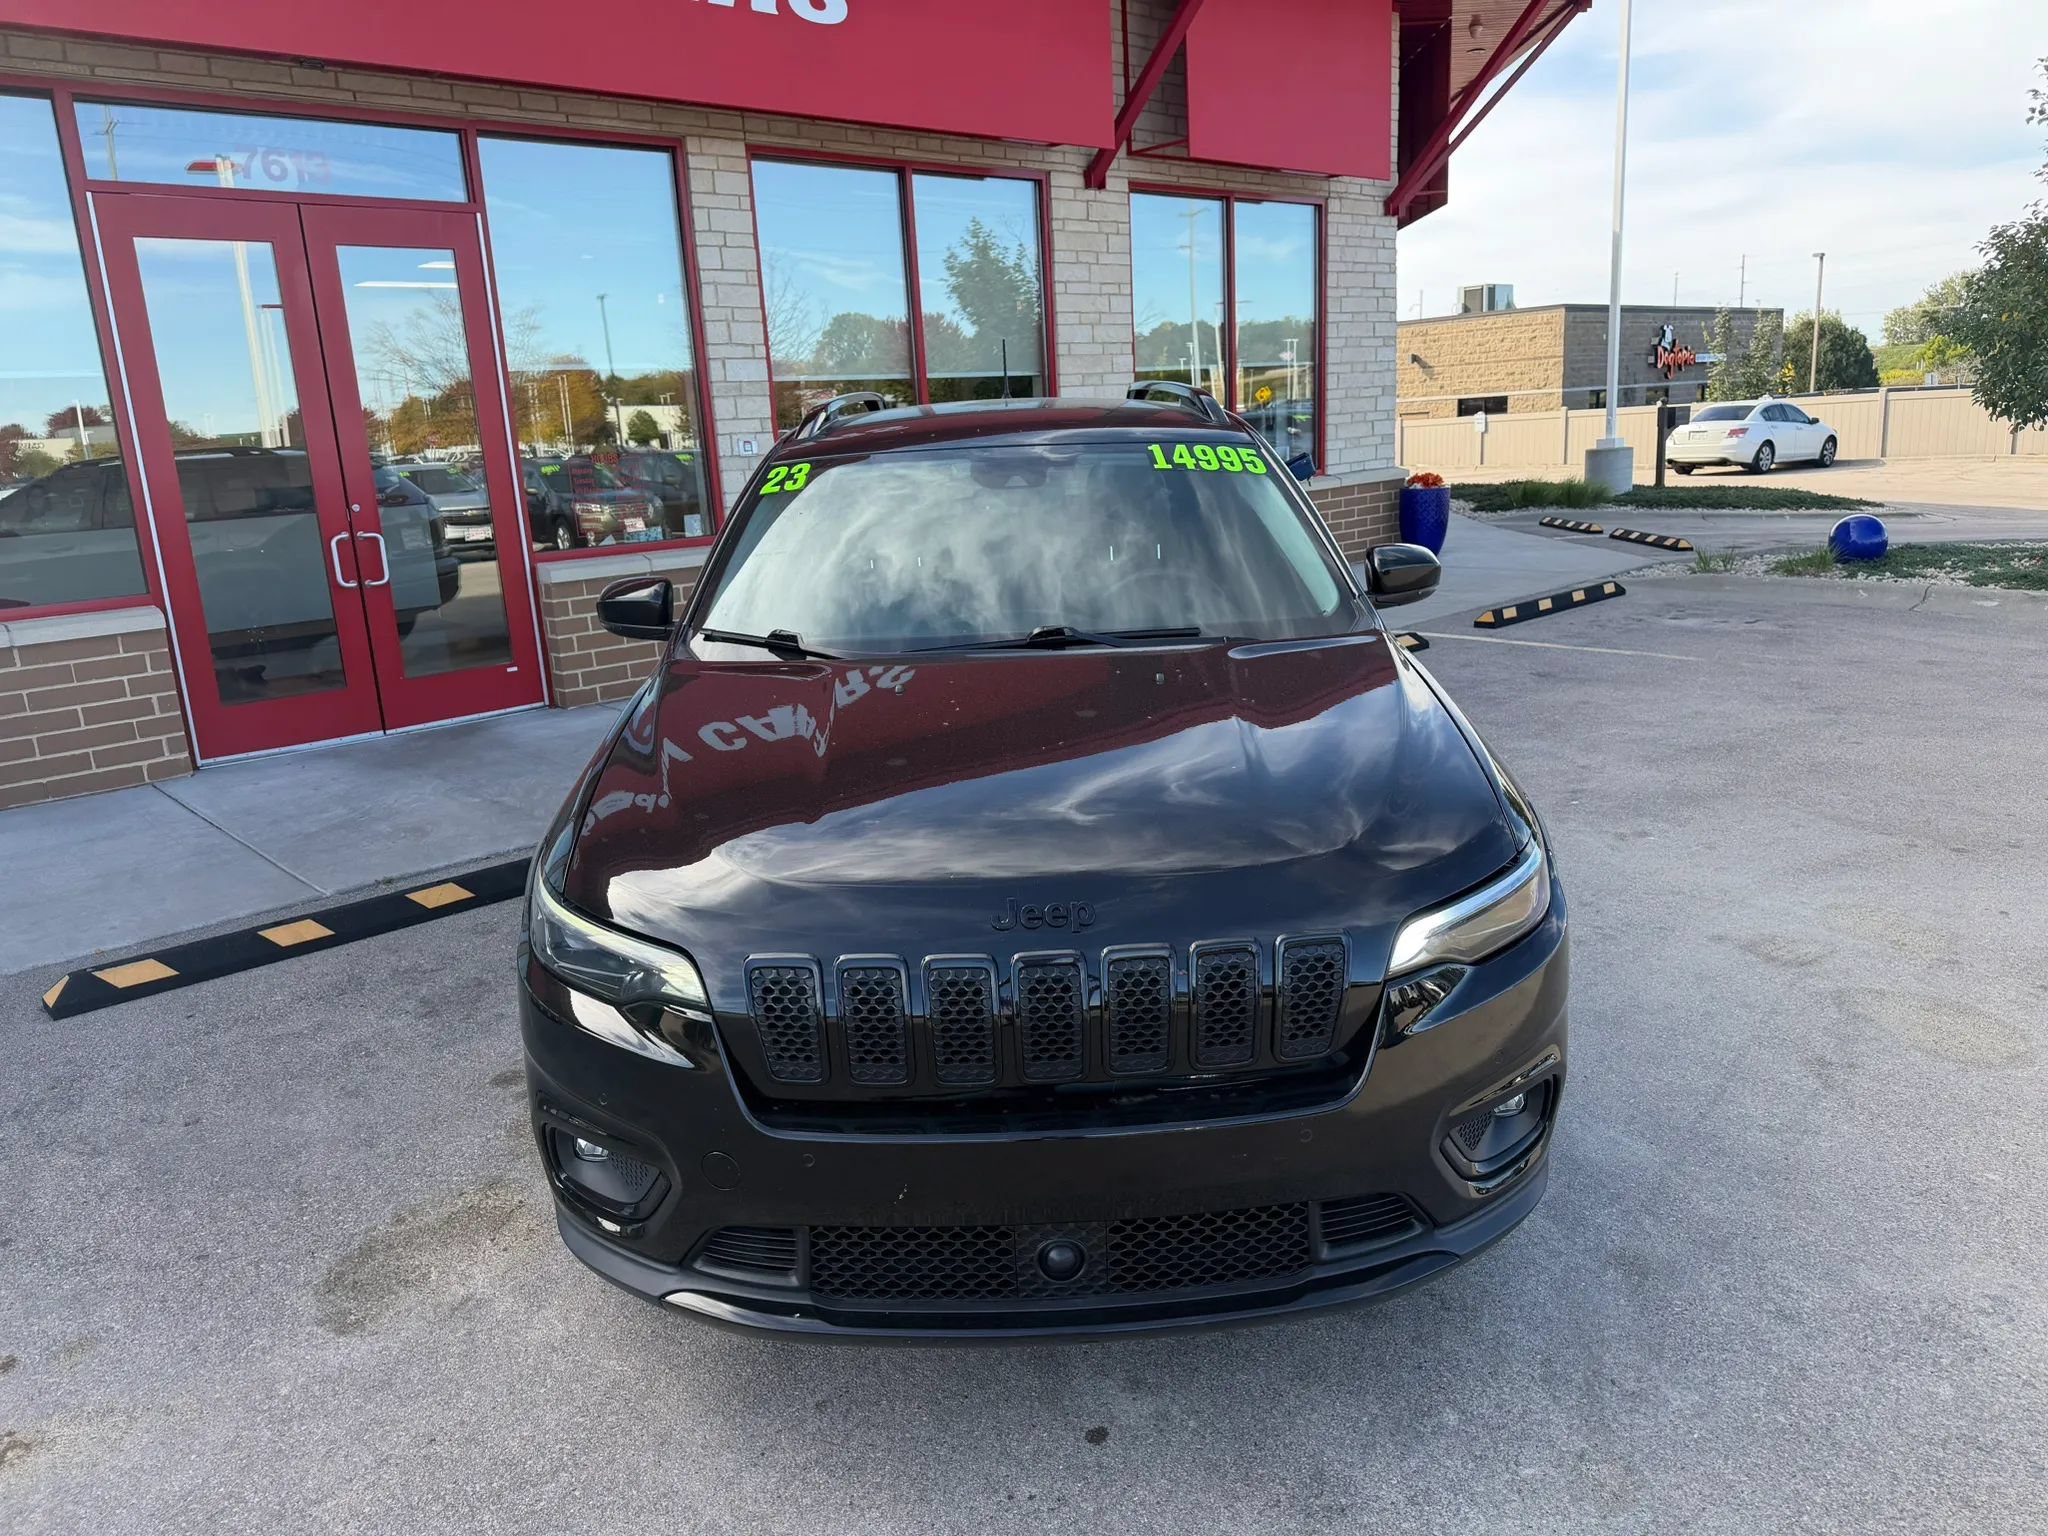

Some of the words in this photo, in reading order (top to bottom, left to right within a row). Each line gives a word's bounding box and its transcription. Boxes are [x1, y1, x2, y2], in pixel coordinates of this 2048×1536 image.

[1147, 444, 1267, 474] 14995
[759, 463, 811, 495] 23
[991, 897, 1096, 933] Jeep
